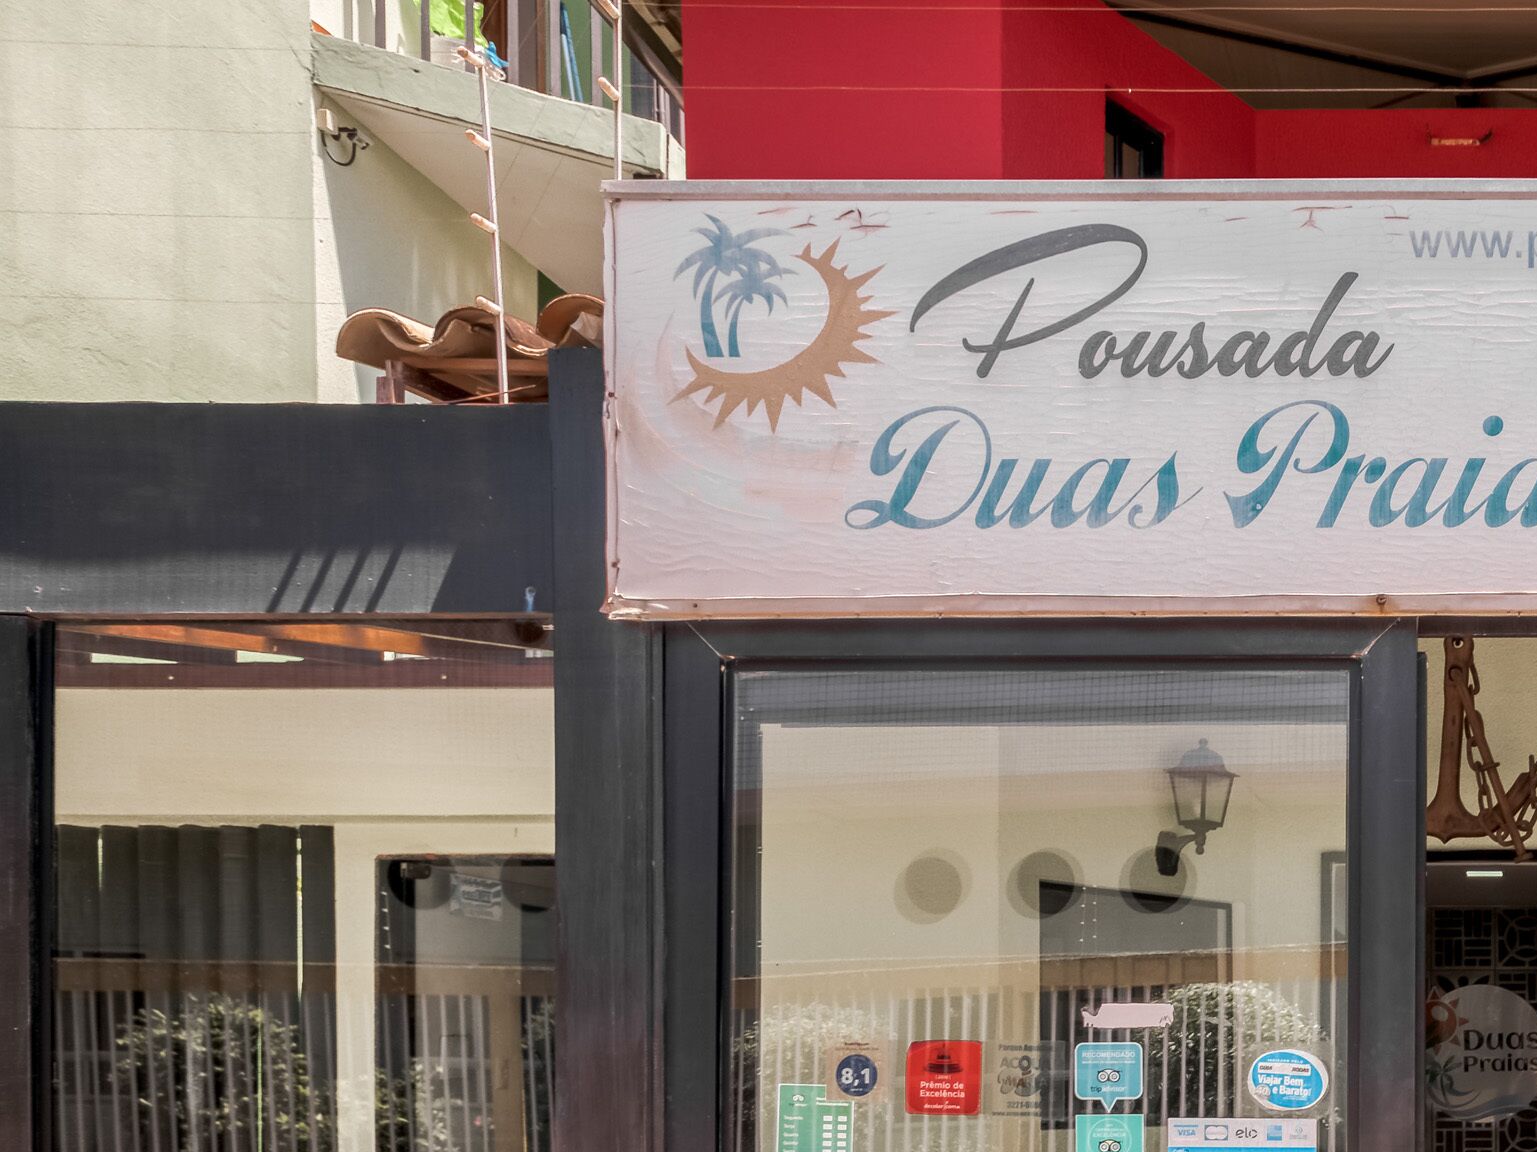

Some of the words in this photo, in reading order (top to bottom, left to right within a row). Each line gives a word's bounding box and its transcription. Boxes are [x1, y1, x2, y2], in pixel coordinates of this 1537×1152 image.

[909, 223, 1396, 381] Pousada
[844, 404, 1203, 531] Duas
[840, 1067, 870, 1087] 8,1
[1257, 1074, 1283, 1087] Viajar
[1283, 1075, 1304, 1086] Bem
[919, 1080, 951, 1090] Prêmio
[952, 1081, 965, 1090] de
[919, 1089, 966, 1099] Excelência
[1235, 1127, 1258, 1139] elo
